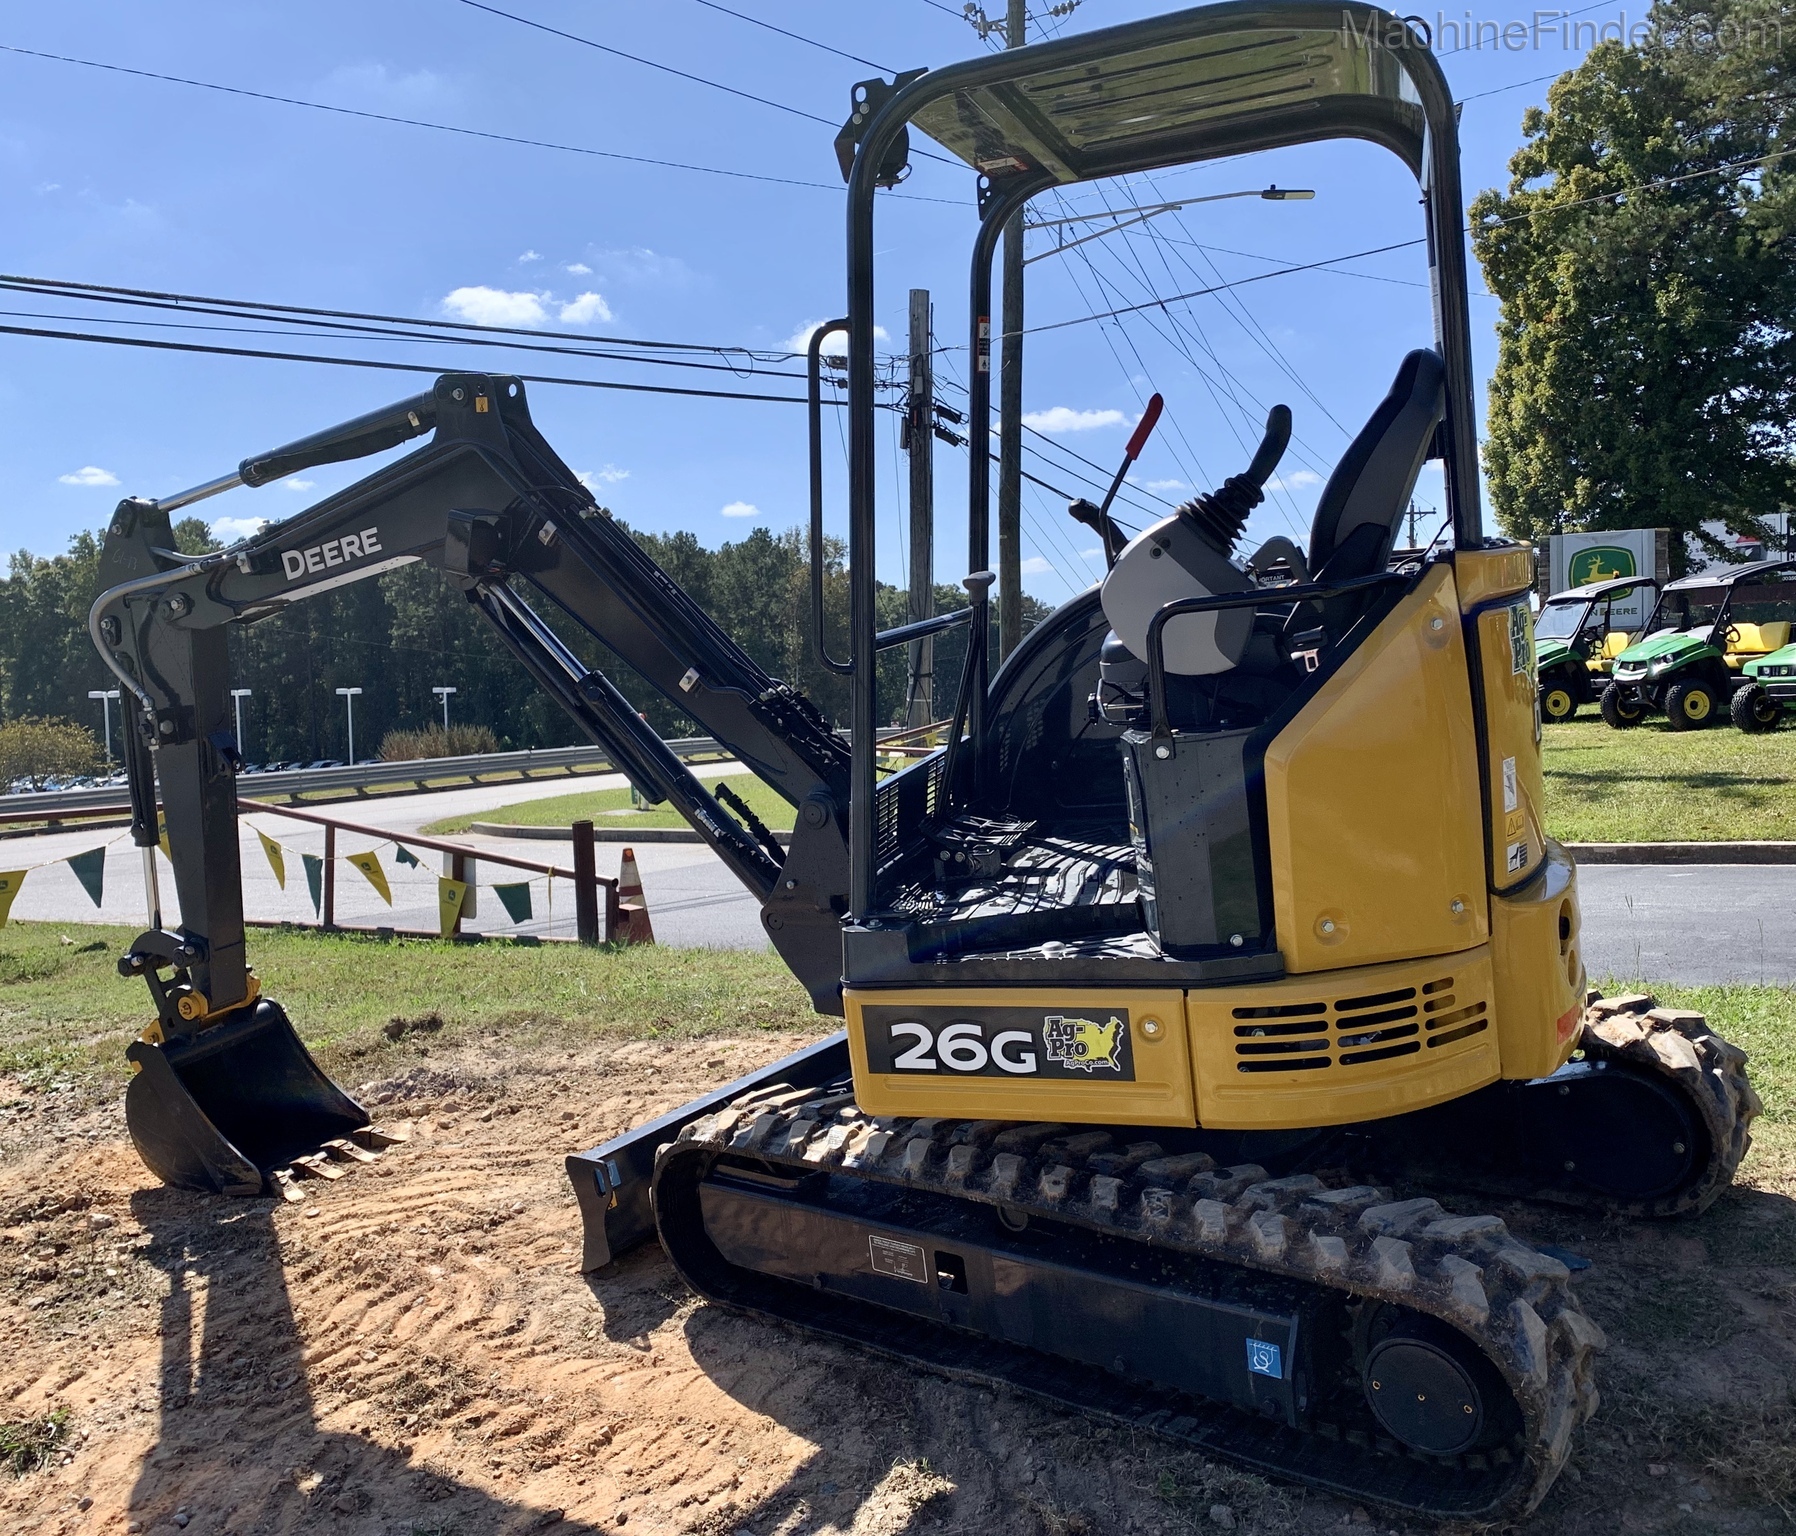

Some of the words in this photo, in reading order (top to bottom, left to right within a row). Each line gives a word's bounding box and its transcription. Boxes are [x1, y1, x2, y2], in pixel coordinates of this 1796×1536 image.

[280, 526, 383, 581] DEERE
[890, 1022, 1038, 1075] 26G
[1048, 1038, 1088, 1058] Pro
